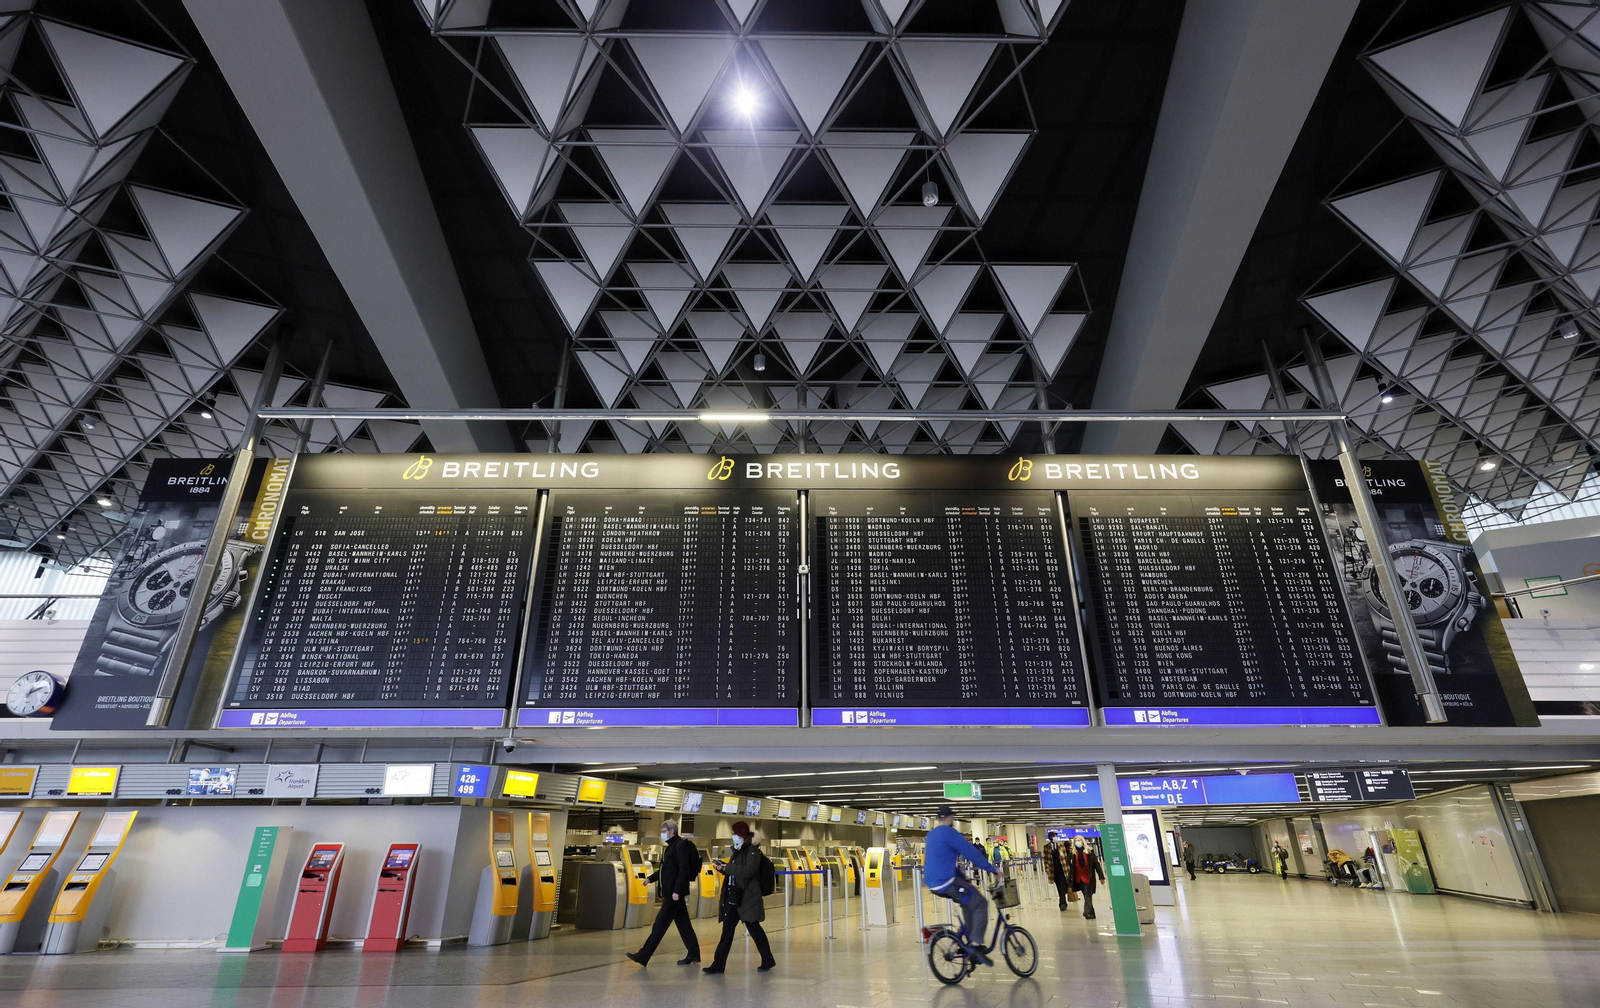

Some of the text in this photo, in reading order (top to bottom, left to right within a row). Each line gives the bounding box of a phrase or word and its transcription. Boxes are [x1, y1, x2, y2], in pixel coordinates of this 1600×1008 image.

[441, 462, 599, 478] BREITLING
[746, 463, 900, 478] BREITLING
[1045, 464, 1199, 479] BREITLING
[167, 477, 228, 485] BREITLIN
[251, 458, 291, 540] CHRONOMAT
[1425, 460, 1469, 541] CHRONOMAT
[460, 775, 480, 784] 428-
[458, 785, 474, 794] 499
[1080, 784, 1086, 793] C
[1168, 794, 1183, 804] D,E
